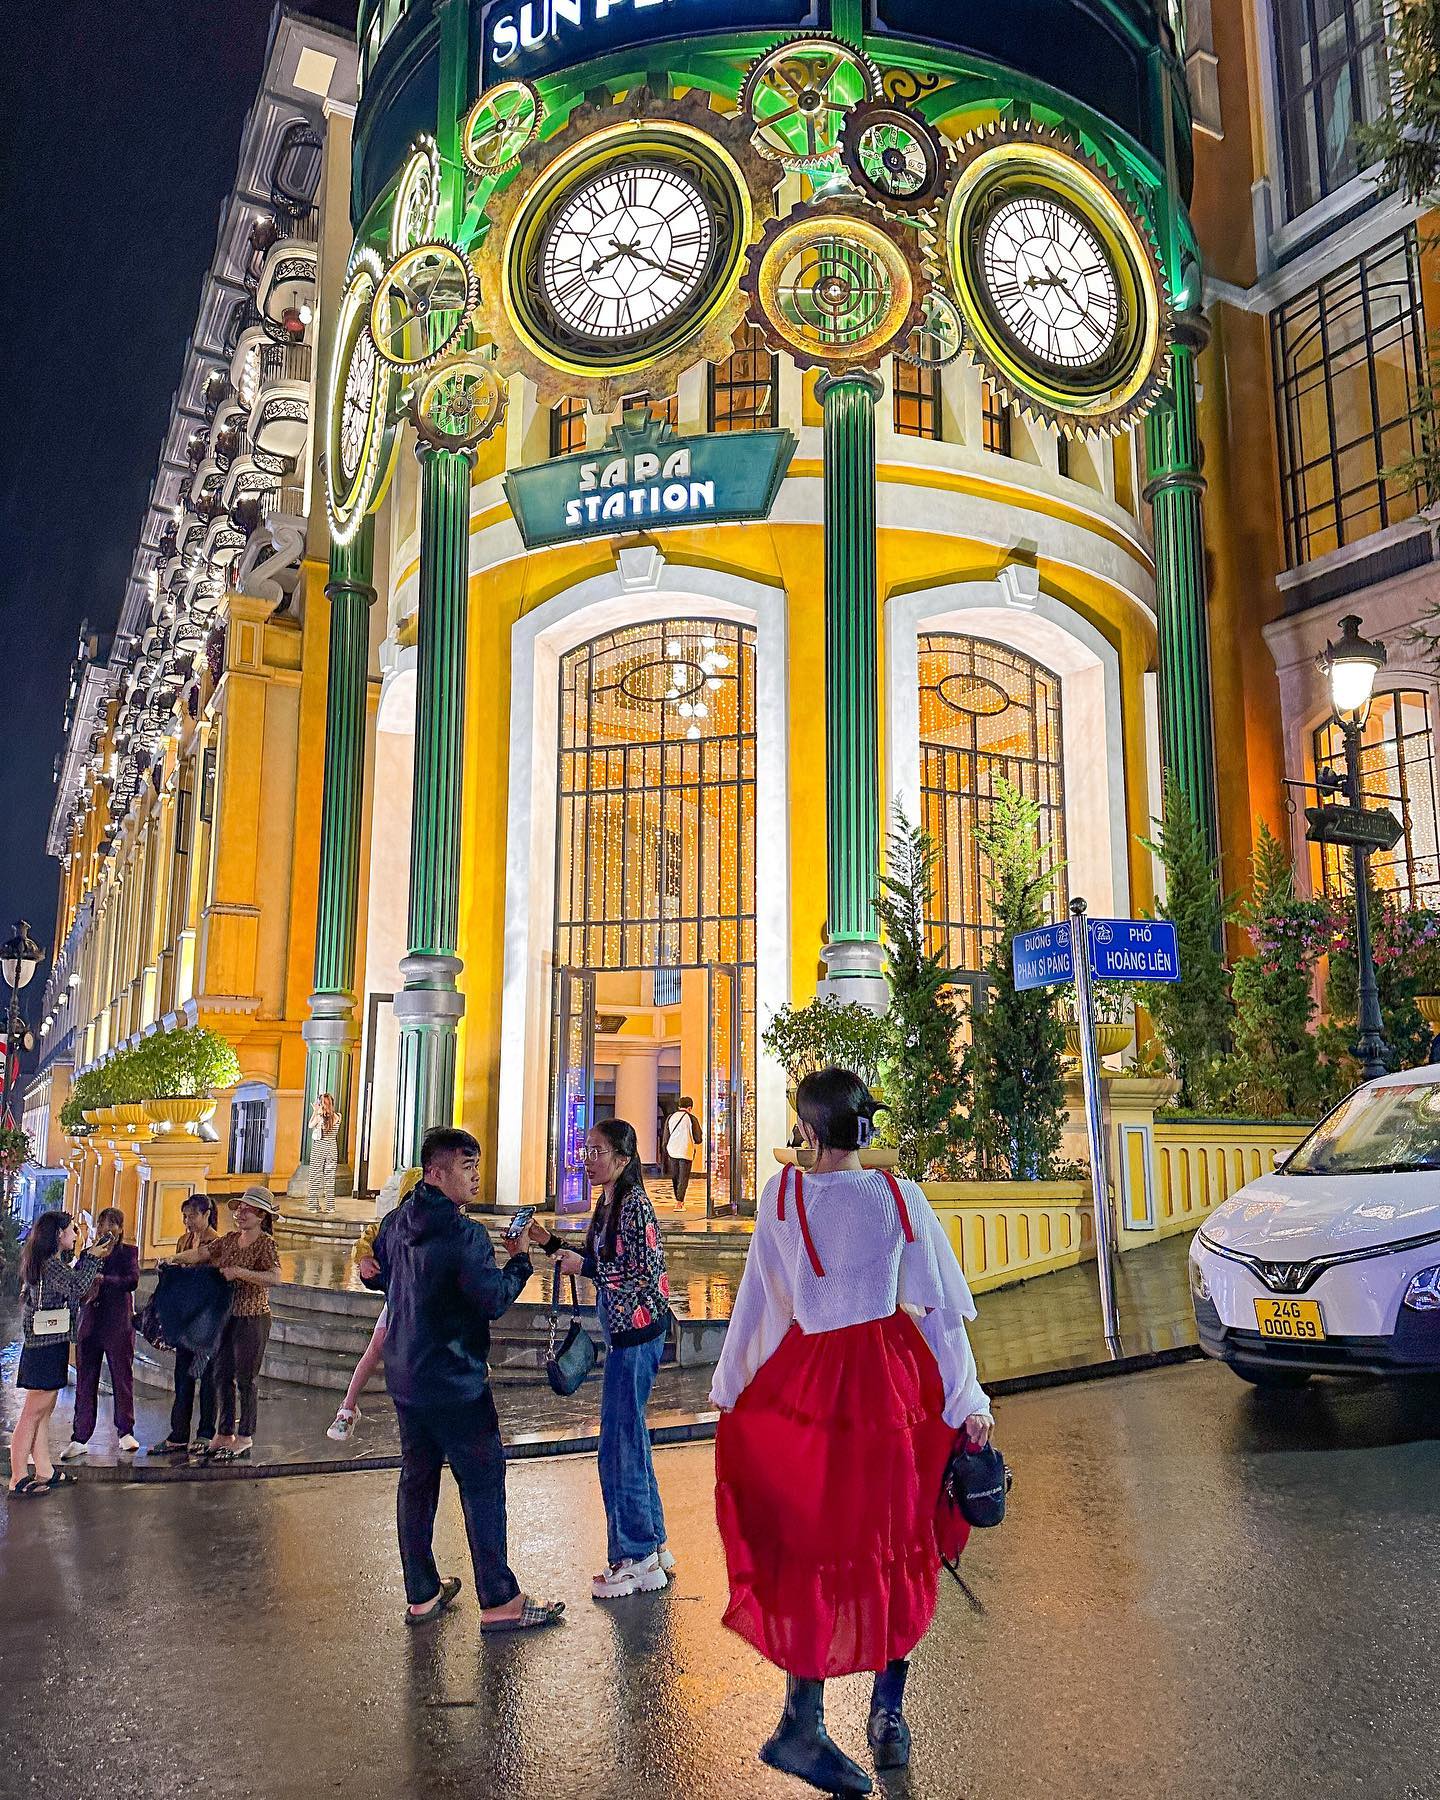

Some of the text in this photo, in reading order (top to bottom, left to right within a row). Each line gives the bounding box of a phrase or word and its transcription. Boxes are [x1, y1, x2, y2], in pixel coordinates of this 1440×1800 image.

[492, 0, 581, 63] SUN
[579, 448, 691, 492] SAPA
[564, 481, 716, 526] STATION
[1017, 960, 1038, 980] PHAN
[1047, 951, 1070, 975] PĂNG
[1106, 947, 1171, 972] HOÀNG LIÊN
[1271, 1301, 1301, 1318] 24G
[1264, 1319, 1317, 1337] 000.69
